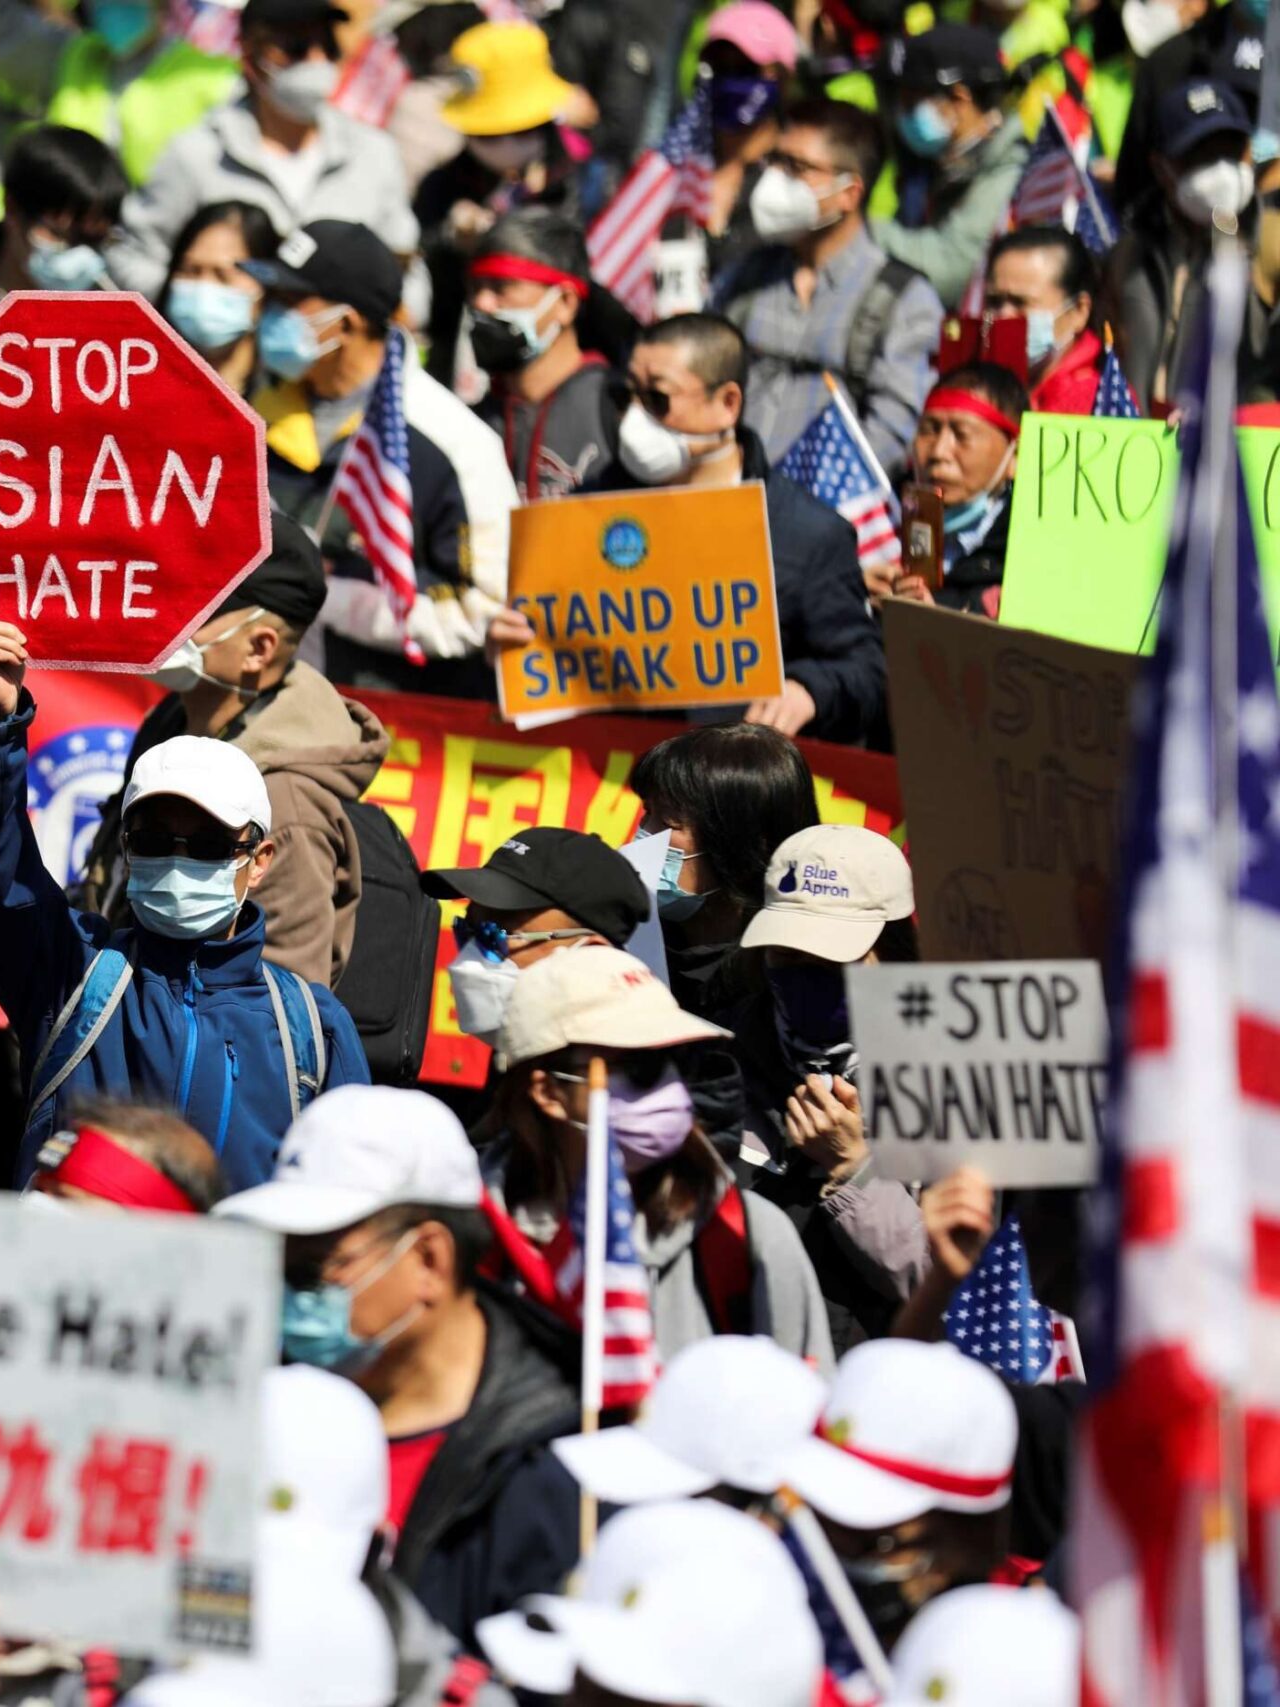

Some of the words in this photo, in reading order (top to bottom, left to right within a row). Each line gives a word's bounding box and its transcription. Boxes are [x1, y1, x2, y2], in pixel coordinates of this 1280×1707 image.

[511, 587, 672, 640] STAND
[691, 581, 759, 630] UP
[523, 644, 677, 698] SPEAK
[693, 640, 760, 687] UP
[801, 879, 849, 898] Apron
[803, 865, 837, 880] Blue
[867, 1062, 1002, 1141] ASIAN
[49, 1288, 248, 1389] Hate!
